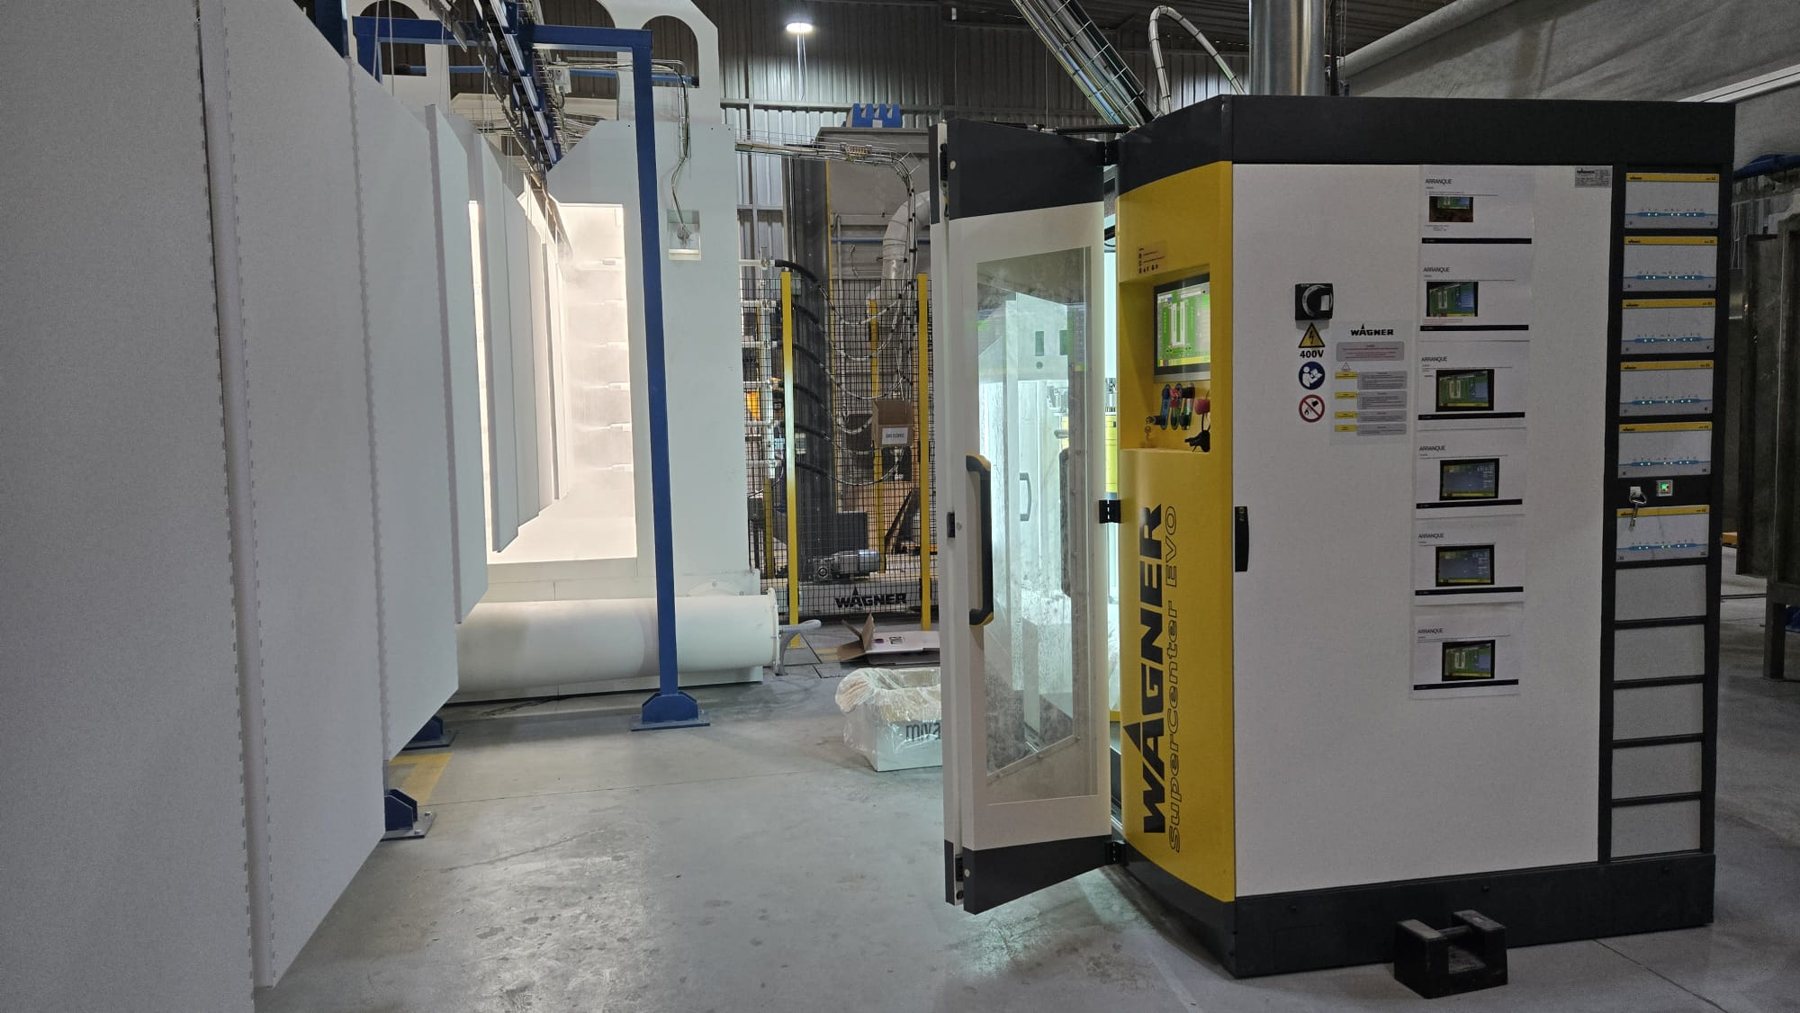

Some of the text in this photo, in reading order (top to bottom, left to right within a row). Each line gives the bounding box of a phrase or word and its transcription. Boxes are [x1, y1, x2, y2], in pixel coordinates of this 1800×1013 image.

[1351, 324, 1394, 336] WAGNER
[1300, 350, 1324, 358] 400V
[835, 587, 907, 608] WAGNER
[1123, 503, 1166, 834] WAGNER
[1165, 505, 1183, 853] SuperCenter EVO
